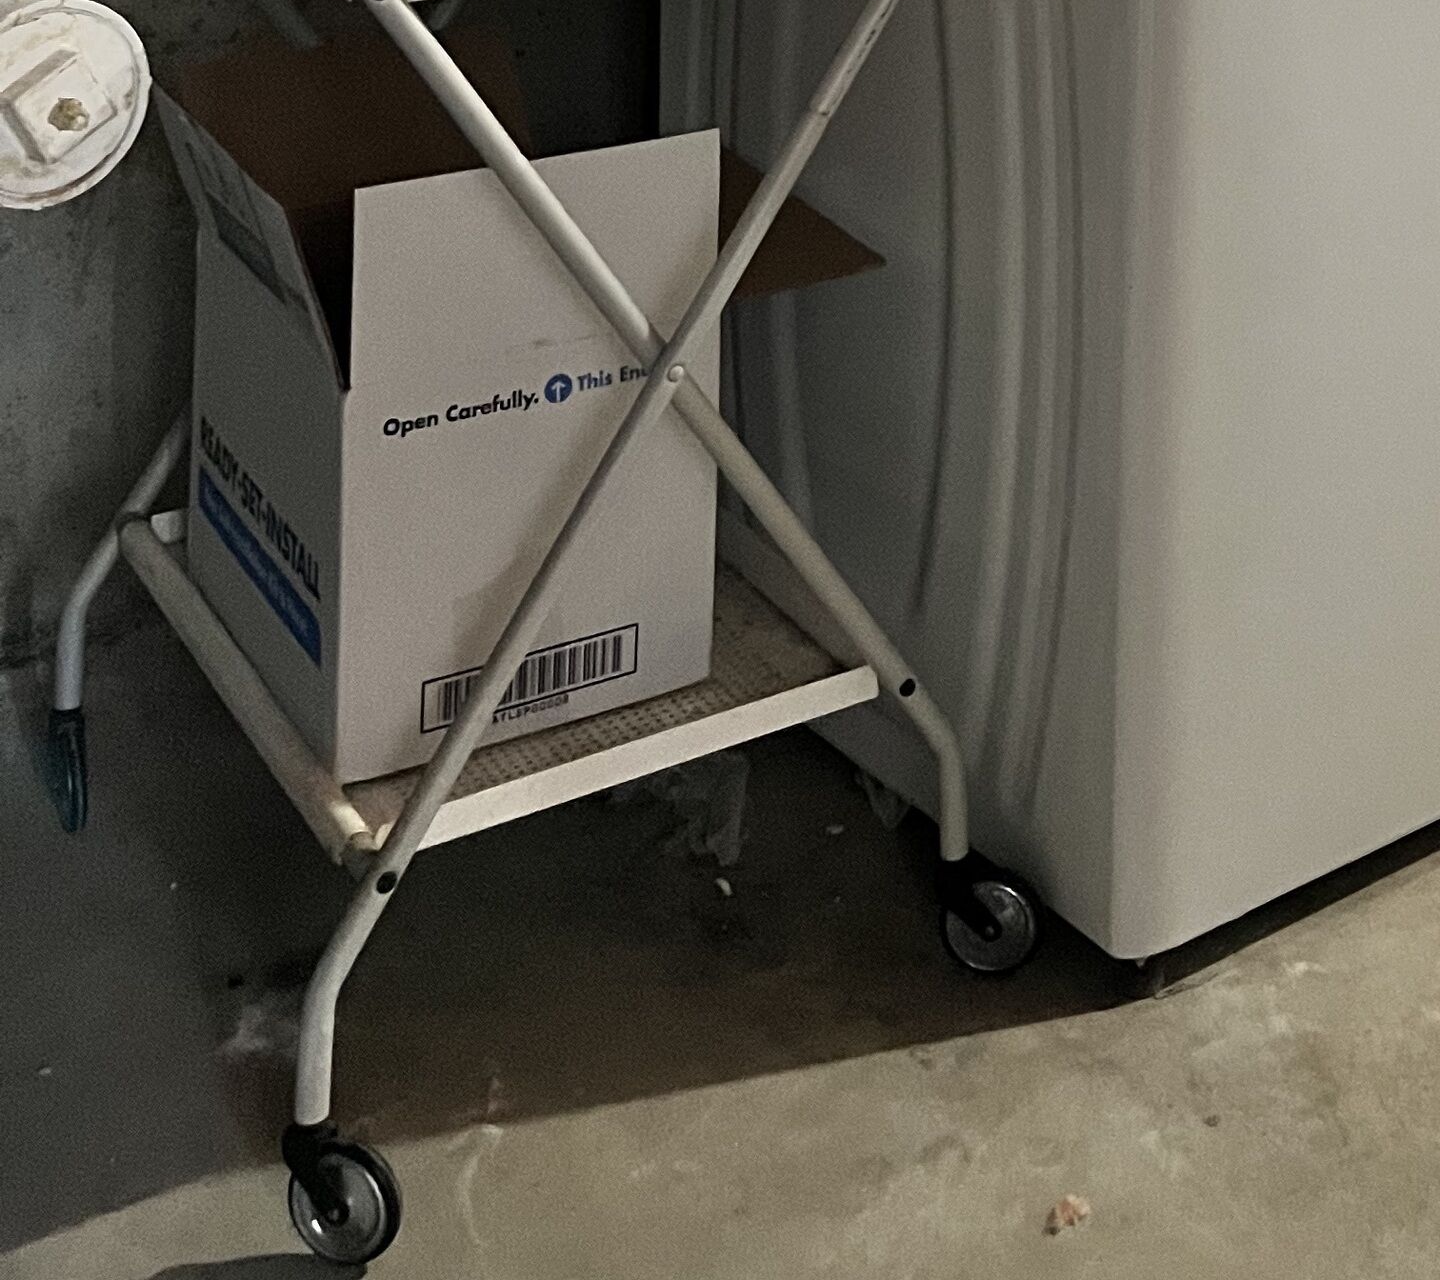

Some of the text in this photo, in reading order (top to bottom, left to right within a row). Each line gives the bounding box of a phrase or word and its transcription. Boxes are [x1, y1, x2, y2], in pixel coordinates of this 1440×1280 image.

[577, 369, 612, 391] This
[383, 388, 539, 438] Open Carefully.
